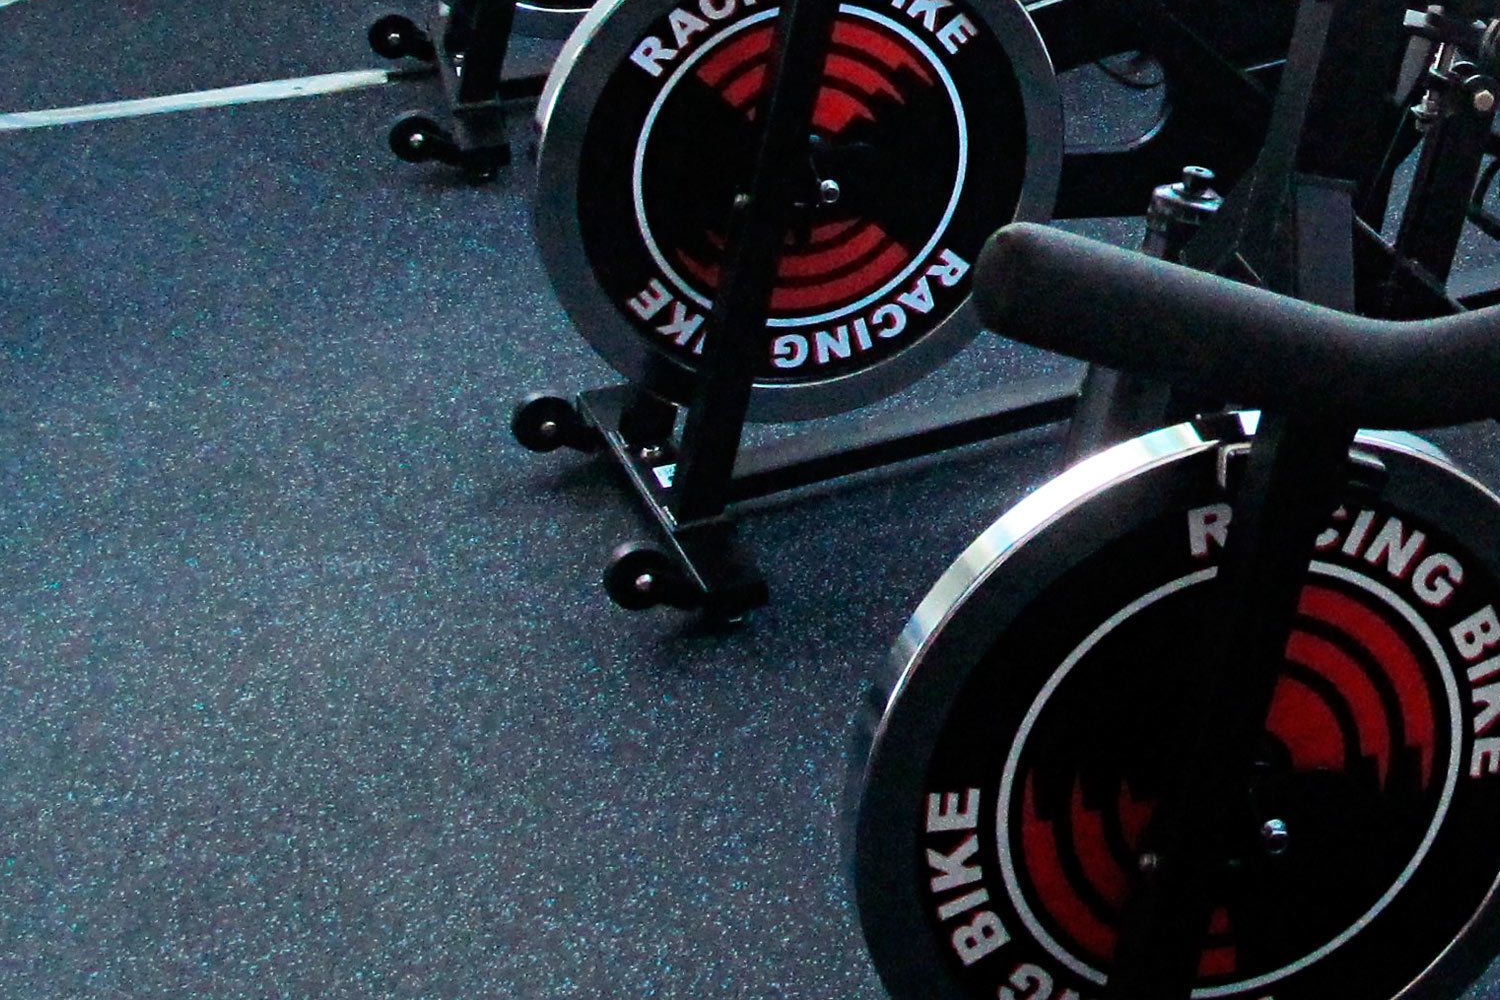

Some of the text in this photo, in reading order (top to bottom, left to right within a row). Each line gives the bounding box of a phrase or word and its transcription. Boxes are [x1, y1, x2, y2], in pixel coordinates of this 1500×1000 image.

[773, 248, 971, 369] RACING
[1187, 502, 1464, 607] RING
[925, 787, 1012, 967] BIKE
